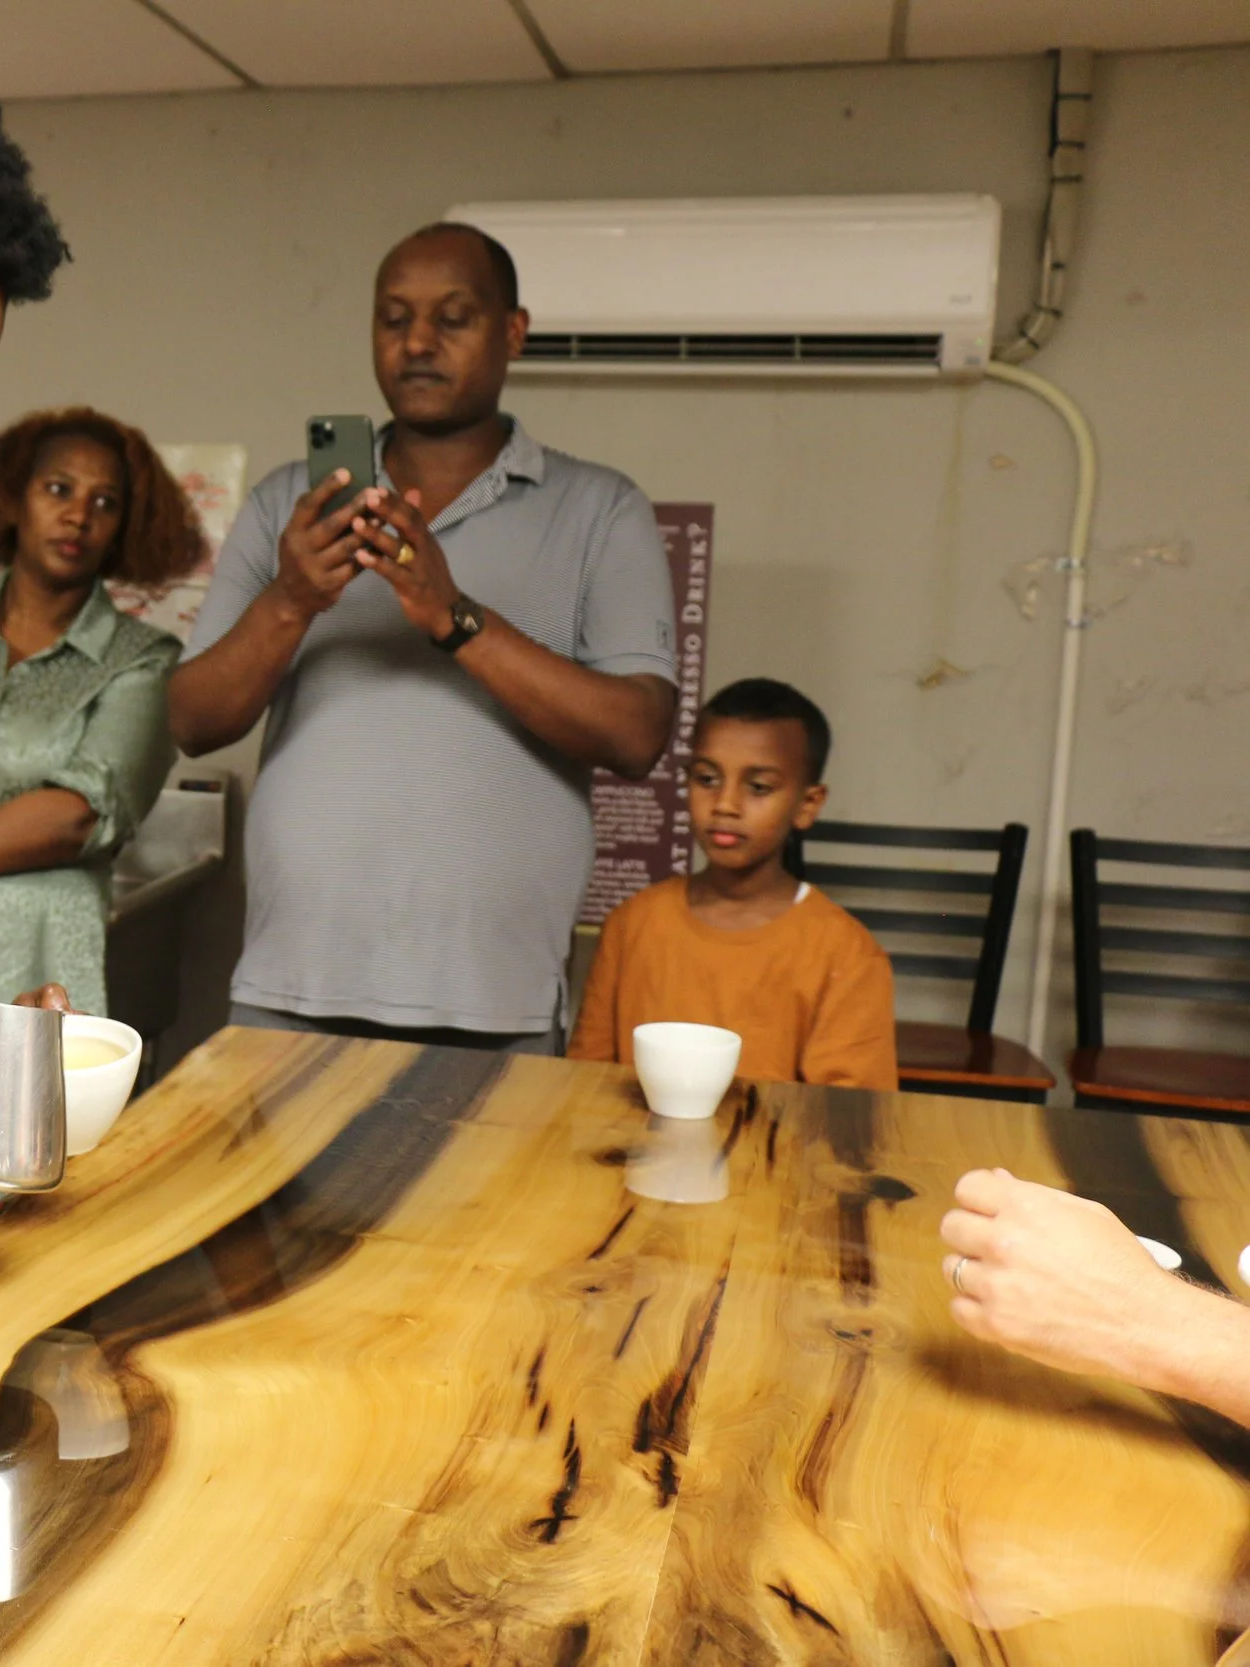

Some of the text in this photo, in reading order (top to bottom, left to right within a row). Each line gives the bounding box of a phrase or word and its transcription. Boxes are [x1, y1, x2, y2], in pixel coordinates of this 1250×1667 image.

[682, 522, 707, 624] DRINK?
[672, 811, 691, 834] IS
[670, 843, 688, 875] AT
